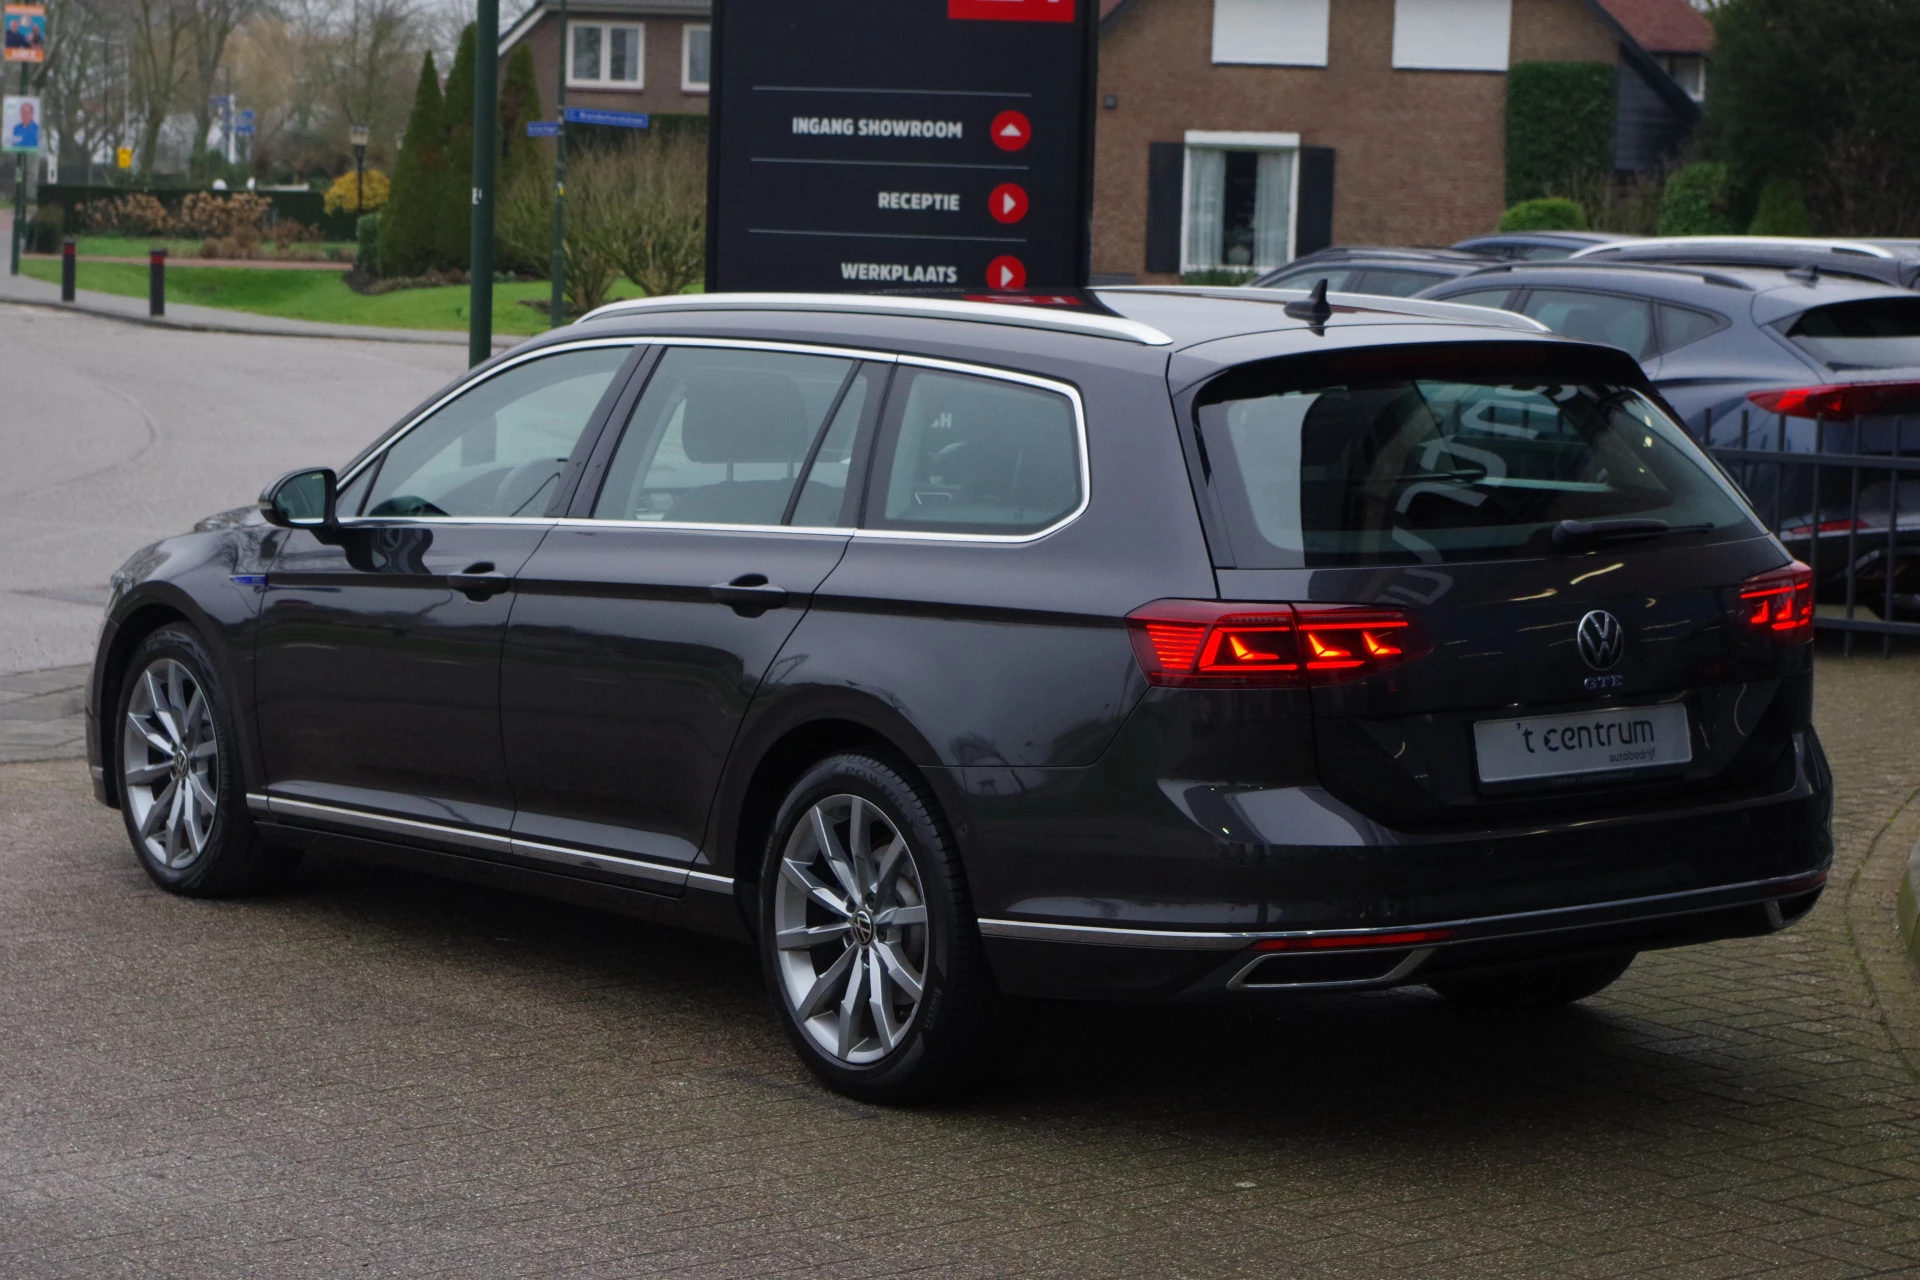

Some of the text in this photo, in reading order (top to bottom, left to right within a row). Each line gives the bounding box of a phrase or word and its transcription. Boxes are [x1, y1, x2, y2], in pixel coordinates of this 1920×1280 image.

[792, 117, 963, 139] INGANG SHOWROOM
[878, 192, 960, 211] RECEPTIE
[841, 262, 958, 283] WERKPLAATS
[1583, 674, 1623, 690] GTE
[1543, 720, 1655, 752] centrum
[1609, 747, 1656, 763] autobedrijf
